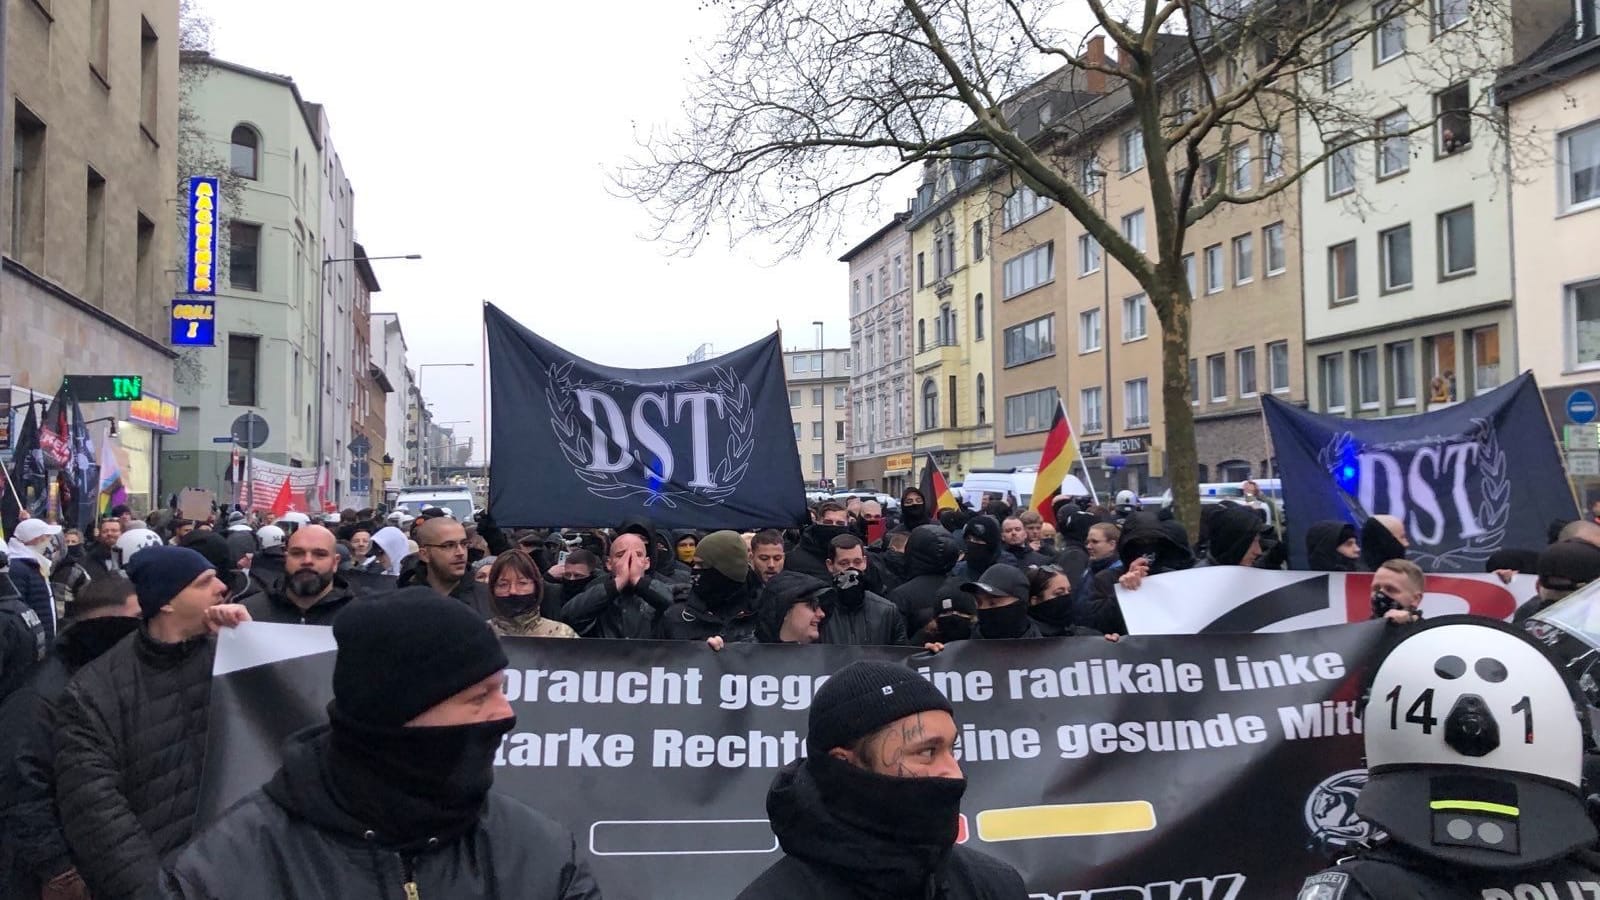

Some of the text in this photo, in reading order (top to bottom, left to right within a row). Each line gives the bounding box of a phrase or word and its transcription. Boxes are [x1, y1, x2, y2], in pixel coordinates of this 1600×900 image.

[576, 389, 726, 490] DST
[1357, 441, 1486, 546] DST
[1008, 658, 1203, 700] radikale
[1214, 651, 1346, 692] Linke
[1056, 712, 1268, 760] gesunde
[1385, 684, 1534, 744] 14 1
